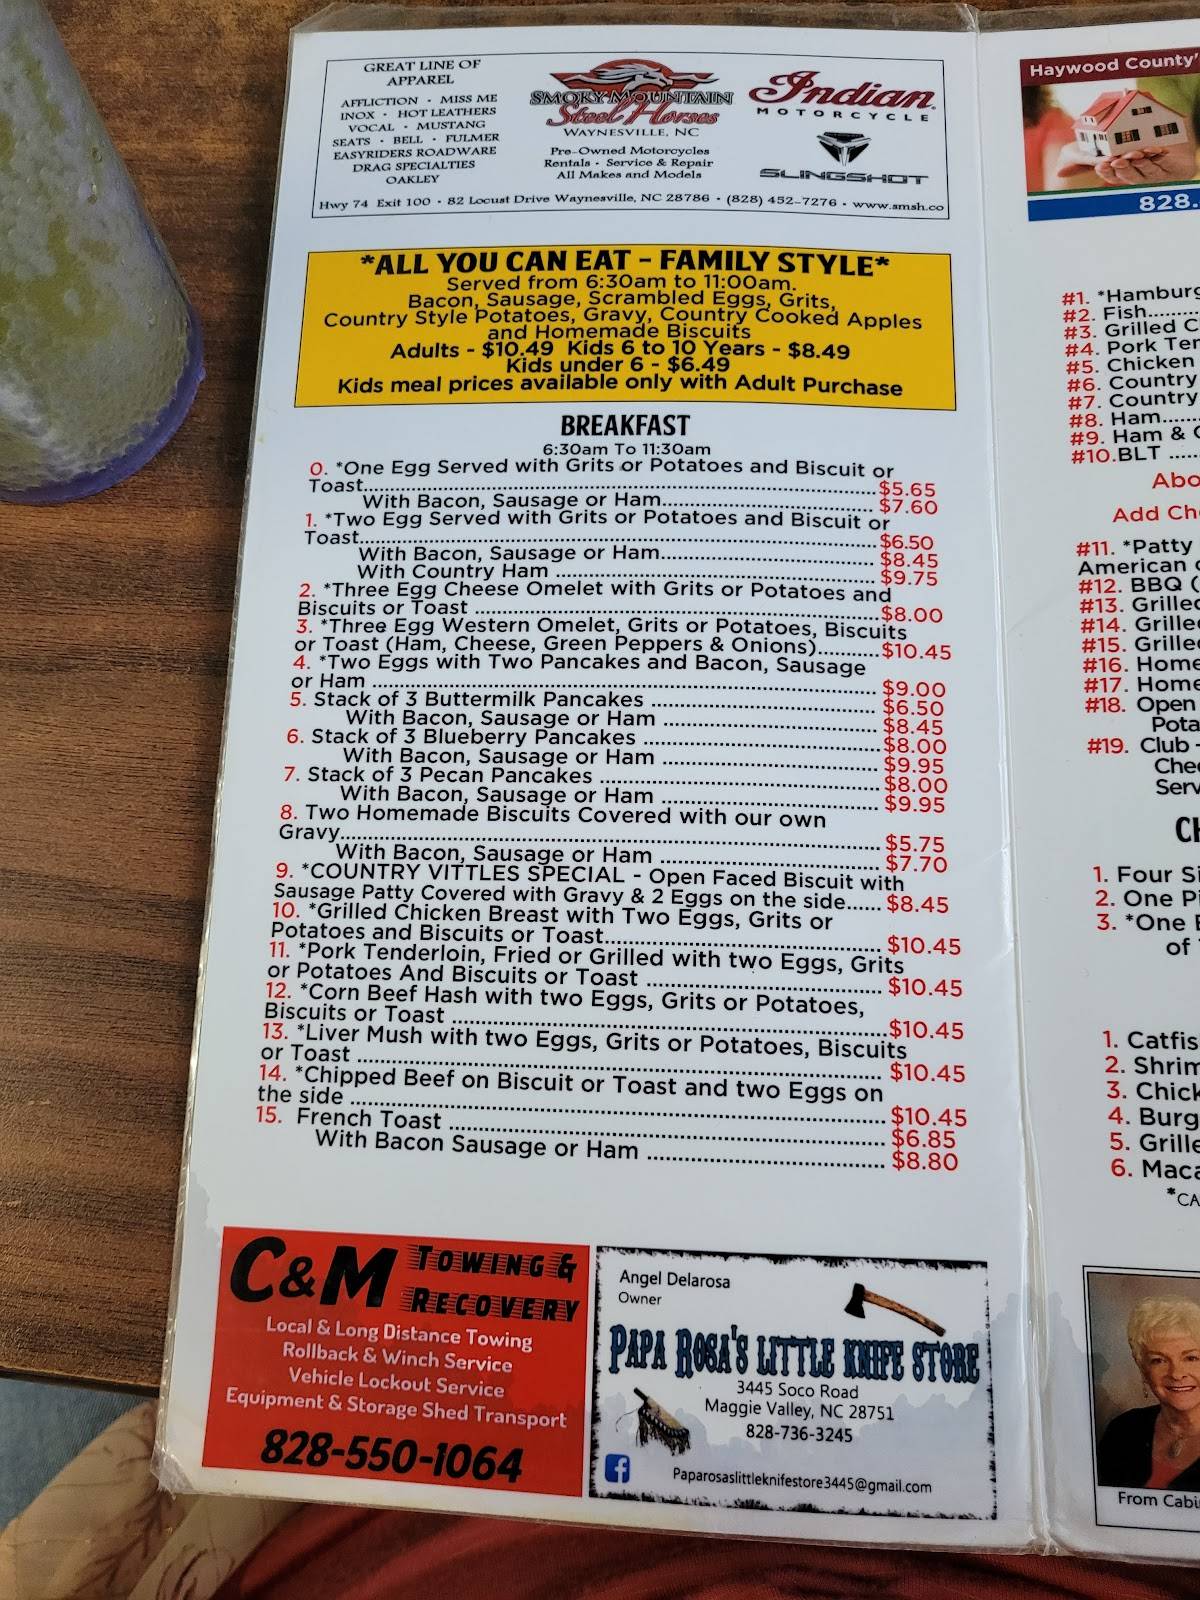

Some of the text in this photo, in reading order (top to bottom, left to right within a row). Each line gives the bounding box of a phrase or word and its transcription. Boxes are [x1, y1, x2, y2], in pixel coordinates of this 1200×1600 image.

[363, 59, 482, 73] GREAT LINE OF
[1030, 58, 1119, 78] Haywood
[386, 74, 455, 87] APPAREL
[749, 70, 935, 109] Indian
[340, 93, 498, 108] AFFLICTION MISS ME
[529, 90, 734, 106] SMOKY MOUNTAIN
[340, 106, 497, 121] INOX HOT LEATHERS
[546, 99, 720, 126] Steel Horses
[757, 107, 929, 122] MOTORCYCLE
[348, 120, 487, 133] VOCAL MUSTANG
[563, 127, 700, 138] WAYNESVILLE, NC
[332, 132, 500, 148] SEATS BELL FULMER
[332, 145, 497, 161] EASYRIDERS ROADWARE
[550, 145, 710, 158] Pre-Owned Motorcycles
[353, 160, 476, 173] DRAG SPECIALTIES
[543, 158, 714, 170] Rentals Service & Repair
[385, 174, 441, 185] OAKLEY
[556, 169, 702, 180] All Makes and Models
[759, 168, 929, 185] SLINGSHOT
[319, 200, 349, 212] Hwy
[353, 199, 369, 209] 74
[376, 198, 402, 208] Exit
[406, 197, 431, 207] 100
[447, 196, 465, 206] 82
[469, 195, 511, 205] Locust
[513, 194, 551, 204] Drive
[554, 193, 637, 206] Waynesville,
[641, 193, 662, 202] NC
[666, 193, 710, 203] 28786
[726, 194, 764, 207] (828)
[768, 195, 838, 208] 452-7276
[438, 251, 498, 275] YOU
[506, 250, 567, 273] CAN
[575, 249, 632, 272] EAT
[659, 249, 768, 273] FAMILY
[338, 372, 903, 397] Kids meal prices available only with Adult Purchase
[1067, 373, 1198, 393] #6. Country
[560, 414, 691, 437] BREAKFAST
[542, 442, 711, 456] 6:30am To 11:30am
[879, 498, 938, 515] $7.60
[1112, 505, 1159, 523] Add
[1076, 540, 1115, 557] #11.
[1078, 558, 1187, 576] American
[1078, 576, 1182, 595] #12. BBQ
[296, 618, 313, 634] 3.
[394, 617, 435, 636] Egg
[441, 617, 530, 633] Western
[537, 616, 620, 636] Omelet,
[627, 617, 679, 633] Grits
[685, 620, 709, 633] or
[716, 619, 817, 638] Potatoes,
[825, 621, 907, 641] Biscuits
[1085, 696, 1196, 716] #18. Open
[884, 795, 945, 814] $9.95
[276, 862, 294, 879] 9.
[428, 863, 520, 882] VITTLES
[528, 865, 626, 883] SPECIAL
[649, 867, 705, 888] Open
[713, 869, 776, 887] Faced
[784, 871, 854, 890] Biscuit
[859, 874, 905, 892] with
[1095, 889, 1174, 908] 2. One
[1096, 913, 1117, 931] 3.
[1166, 937, 1191, 956] of
[892, 1150, 959, 1172] $8.80
[229, 1235, 399, 1308] C&M
[410, 1244, 578, 1284] TOWING &
[619, 1269, 731, 1289] Angel Delarosa
[408, 1286, 581, 1322] RECOVERY
[618, 1291, 662, 1305] Owner
[266, 1315, 533, 1353] Local & Long Distance Towing
[282, 1341, 513, 1374] Rollback & Winch Service
[608, 1323, 981, 1384] PAPA ROSA'S LITTLE KNIFE STORE
[289, 1366, 505, 1399] Vehicle Lockout Service
[736, 1380, 859, 1400] 3445 Soco Road
[226, 1386, 568, 1431] Equipment & Storage Shed Transport
[705, 1398, 895, 1421] Maggie Valley, NC 28751
[746, 1423, 853, 1443] 828-736-3245
[260, 1428, 523, 1483] 828-550-1064
[673, 1466, 933, 1495] Paparosaslittleknifestore3445@gmail.com
[1118, 1491, 1158, 1506] From
